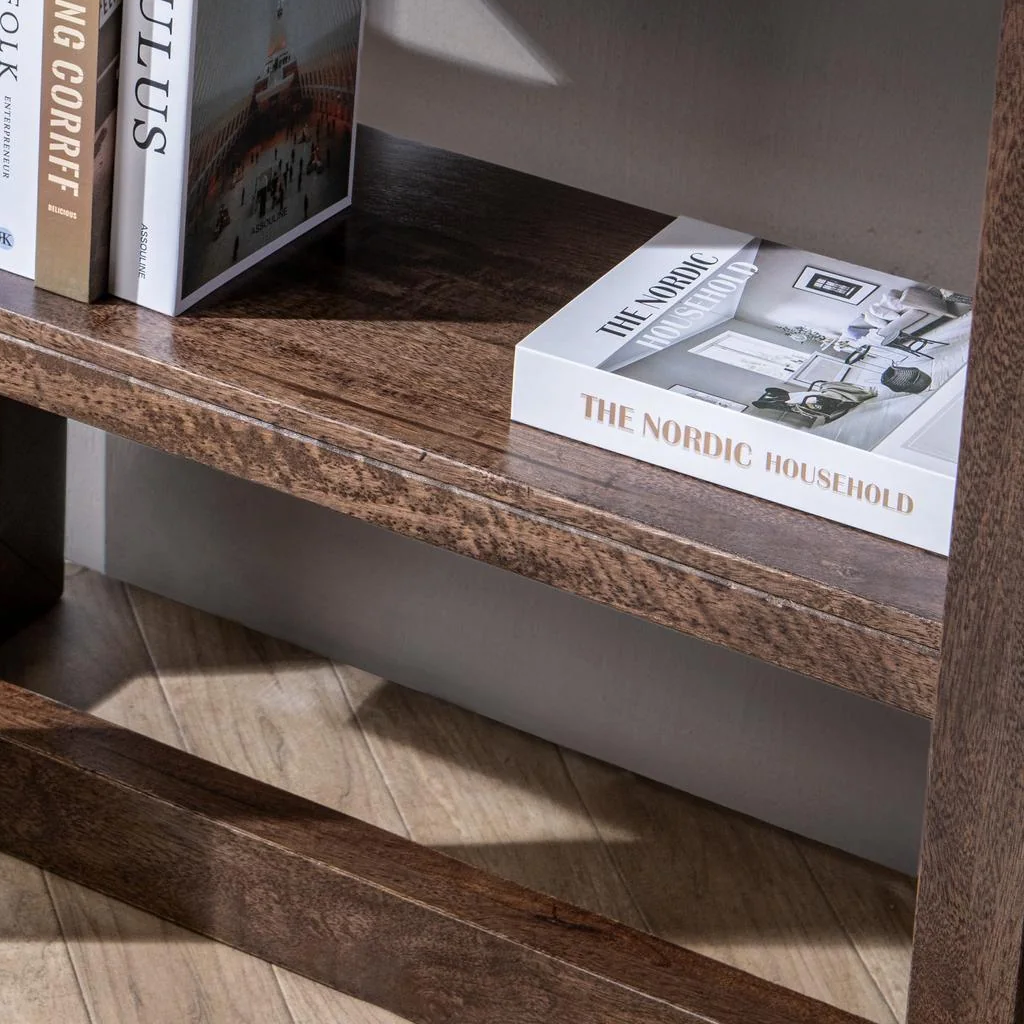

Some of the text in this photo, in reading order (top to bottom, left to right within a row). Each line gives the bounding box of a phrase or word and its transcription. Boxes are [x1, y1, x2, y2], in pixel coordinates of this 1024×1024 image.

[138, 223, 148, 279] ASSOULINE
[595, 252, 719, 338] THE NORDIC
[636, 261, 759, 350] HOUSEHOLD
[580, 392, 914, 514] THE NORDIC HOUSEHOLD
